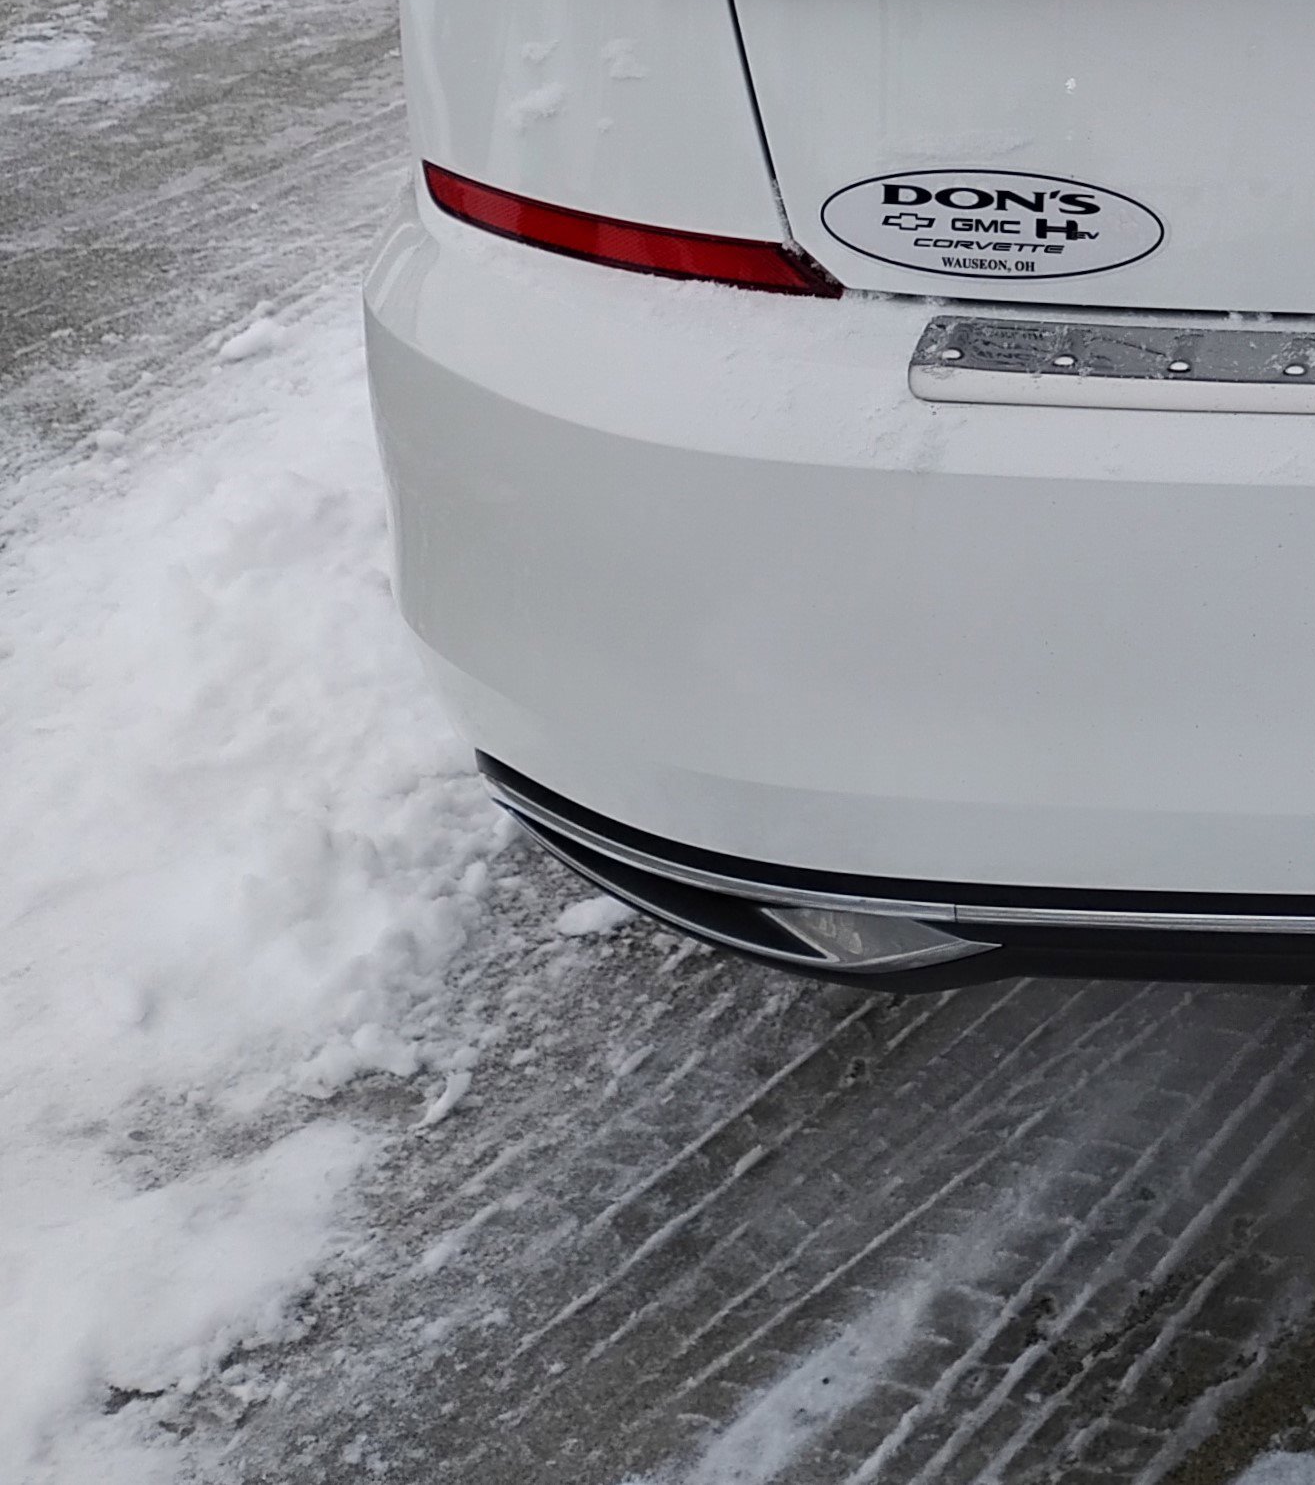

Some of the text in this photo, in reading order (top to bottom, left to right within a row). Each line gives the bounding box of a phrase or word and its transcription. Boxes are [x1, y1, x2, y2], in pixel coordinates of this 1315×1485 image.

[881, 184, 1101, 215] DON'S
[951, 217, 1021, 235] GMC
[913, 238, 1065, 254] CORVETTE
[942, 256, 1036, 274] WAUSEON, OH
